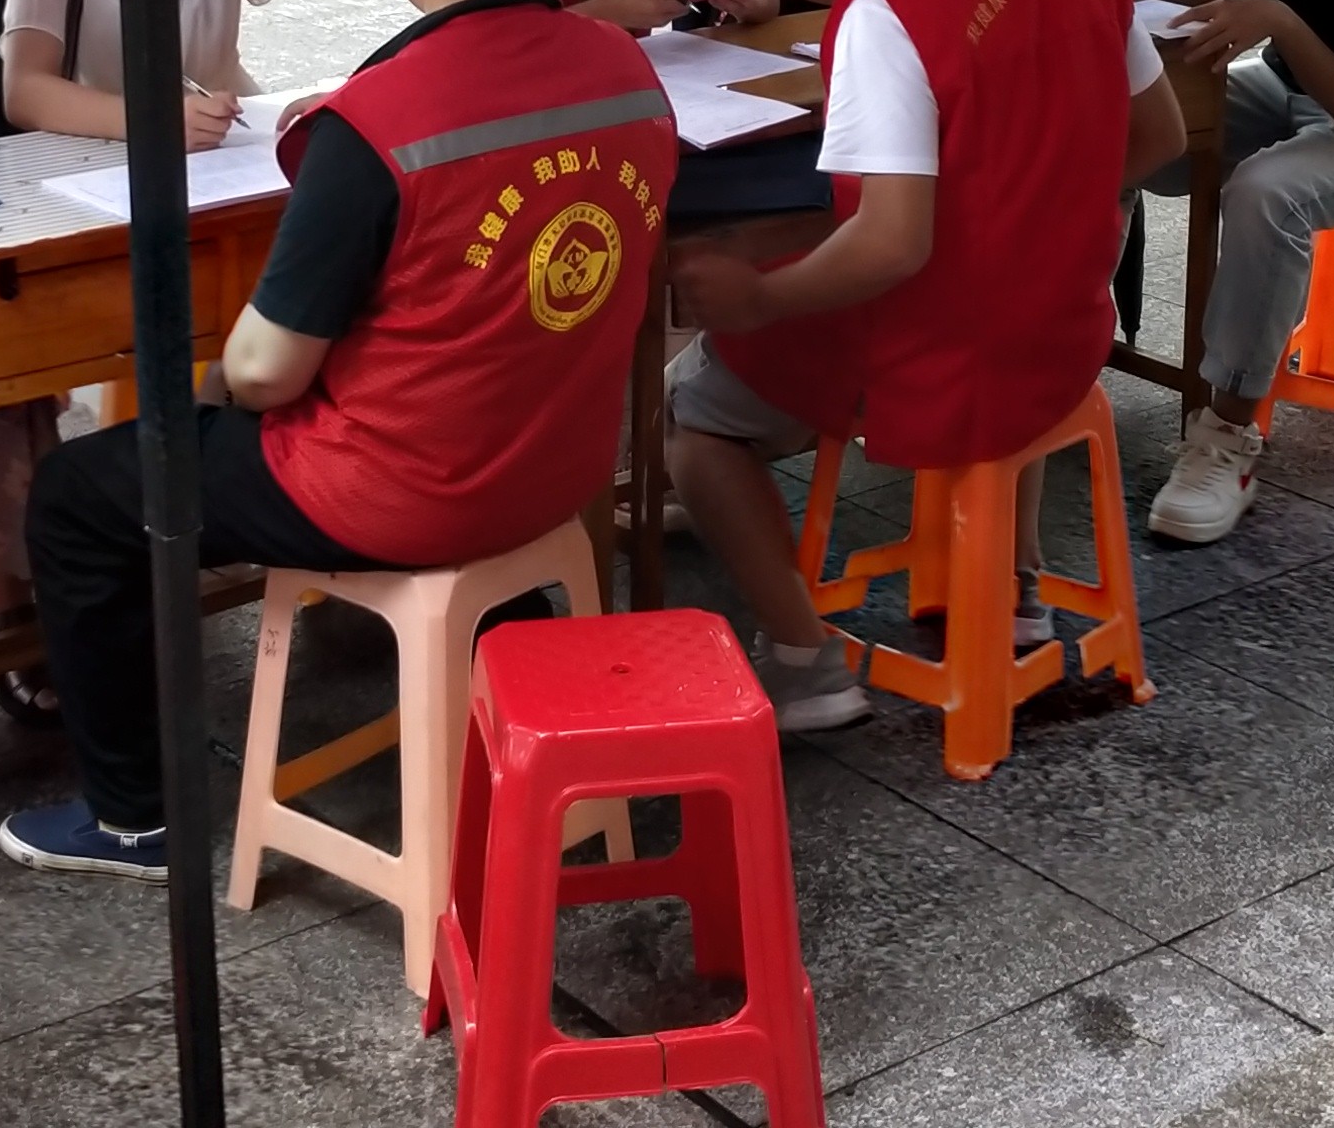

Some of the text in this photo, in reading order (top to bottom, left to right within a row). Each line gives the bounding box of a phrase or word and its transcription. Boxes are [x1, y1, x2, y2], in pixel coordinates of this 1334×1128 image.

[463, 184, 525, 269] 我健康
[532, 146, 601, 185] 我助人
[618, 160, 662, 233] 我快乐
